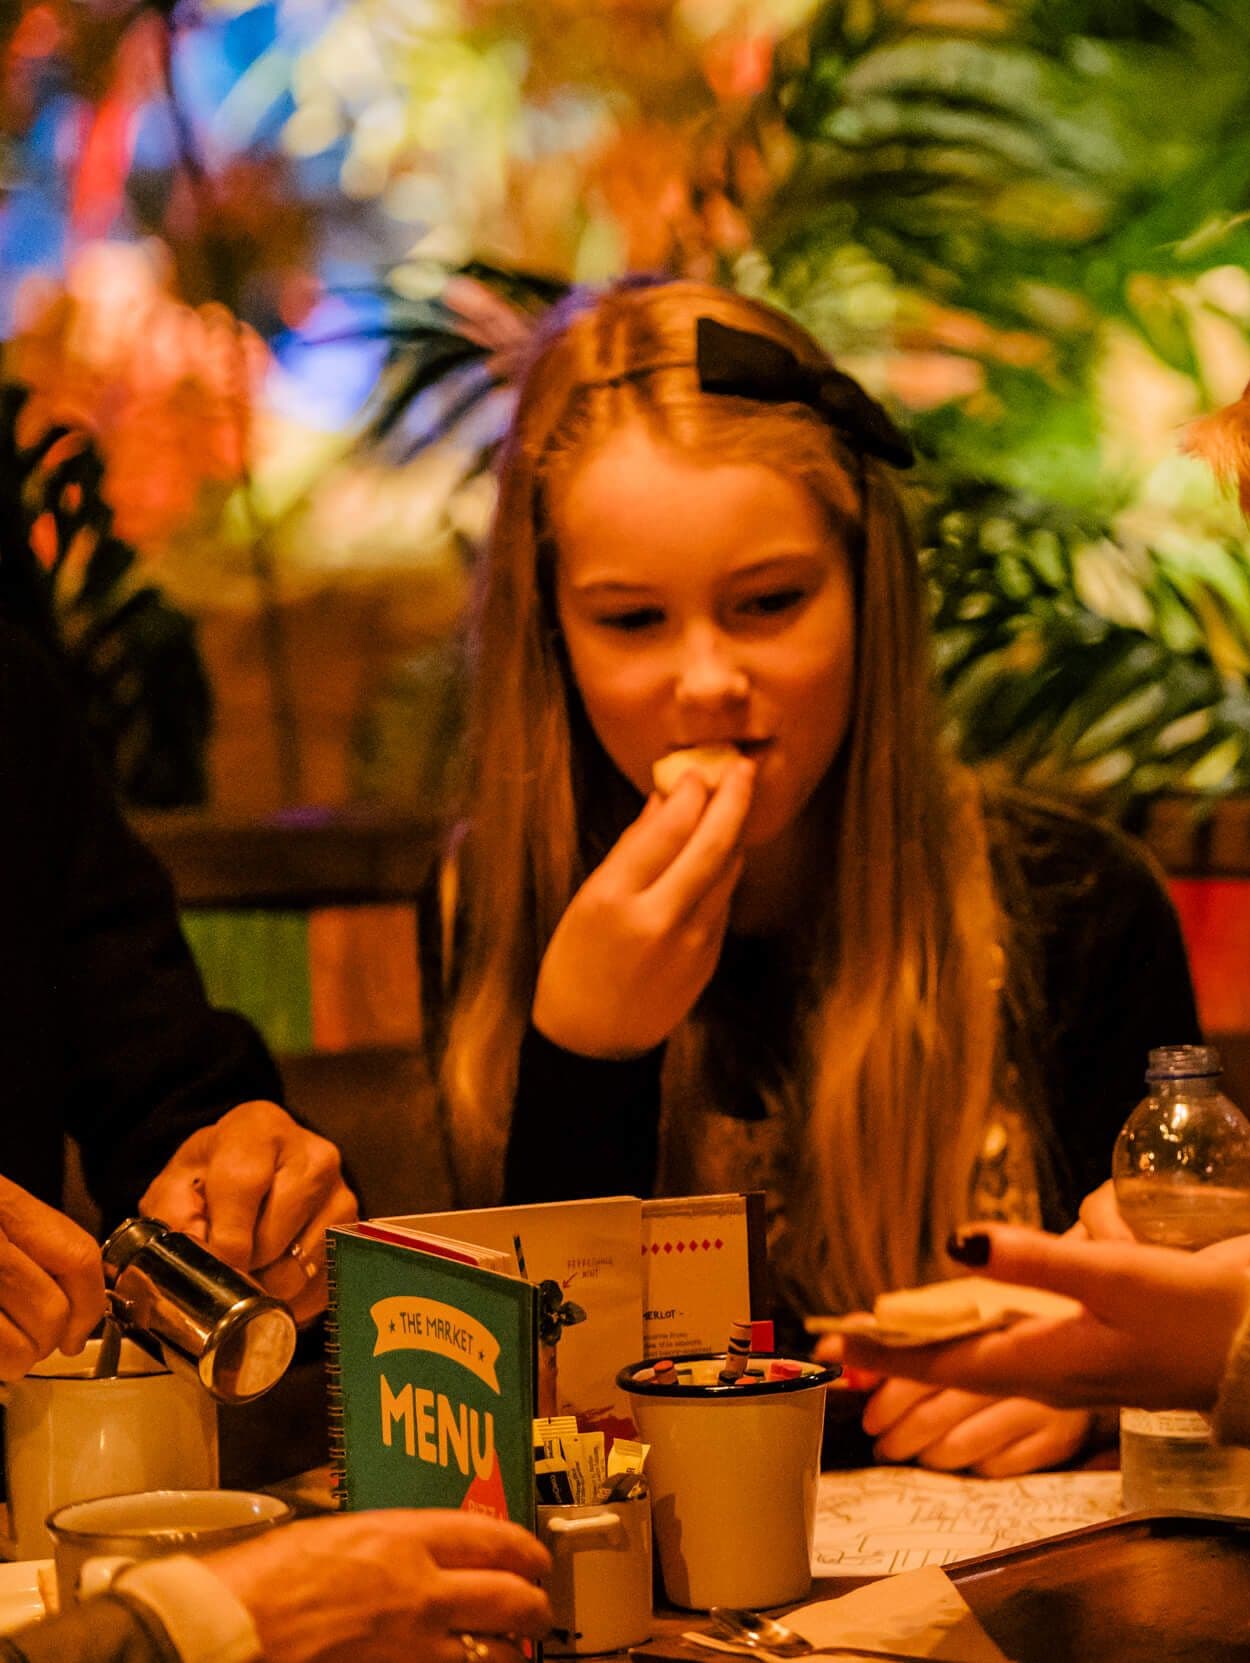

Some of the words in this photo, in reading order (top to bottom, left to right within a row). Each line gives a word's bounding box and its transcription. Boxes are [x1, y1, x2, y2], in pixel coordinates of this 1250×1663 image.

[400, 1312, 422, 1335] THE
[426, 1315, 474, 1355] MARKET
[380, 1373, 495, 1481] MENU
